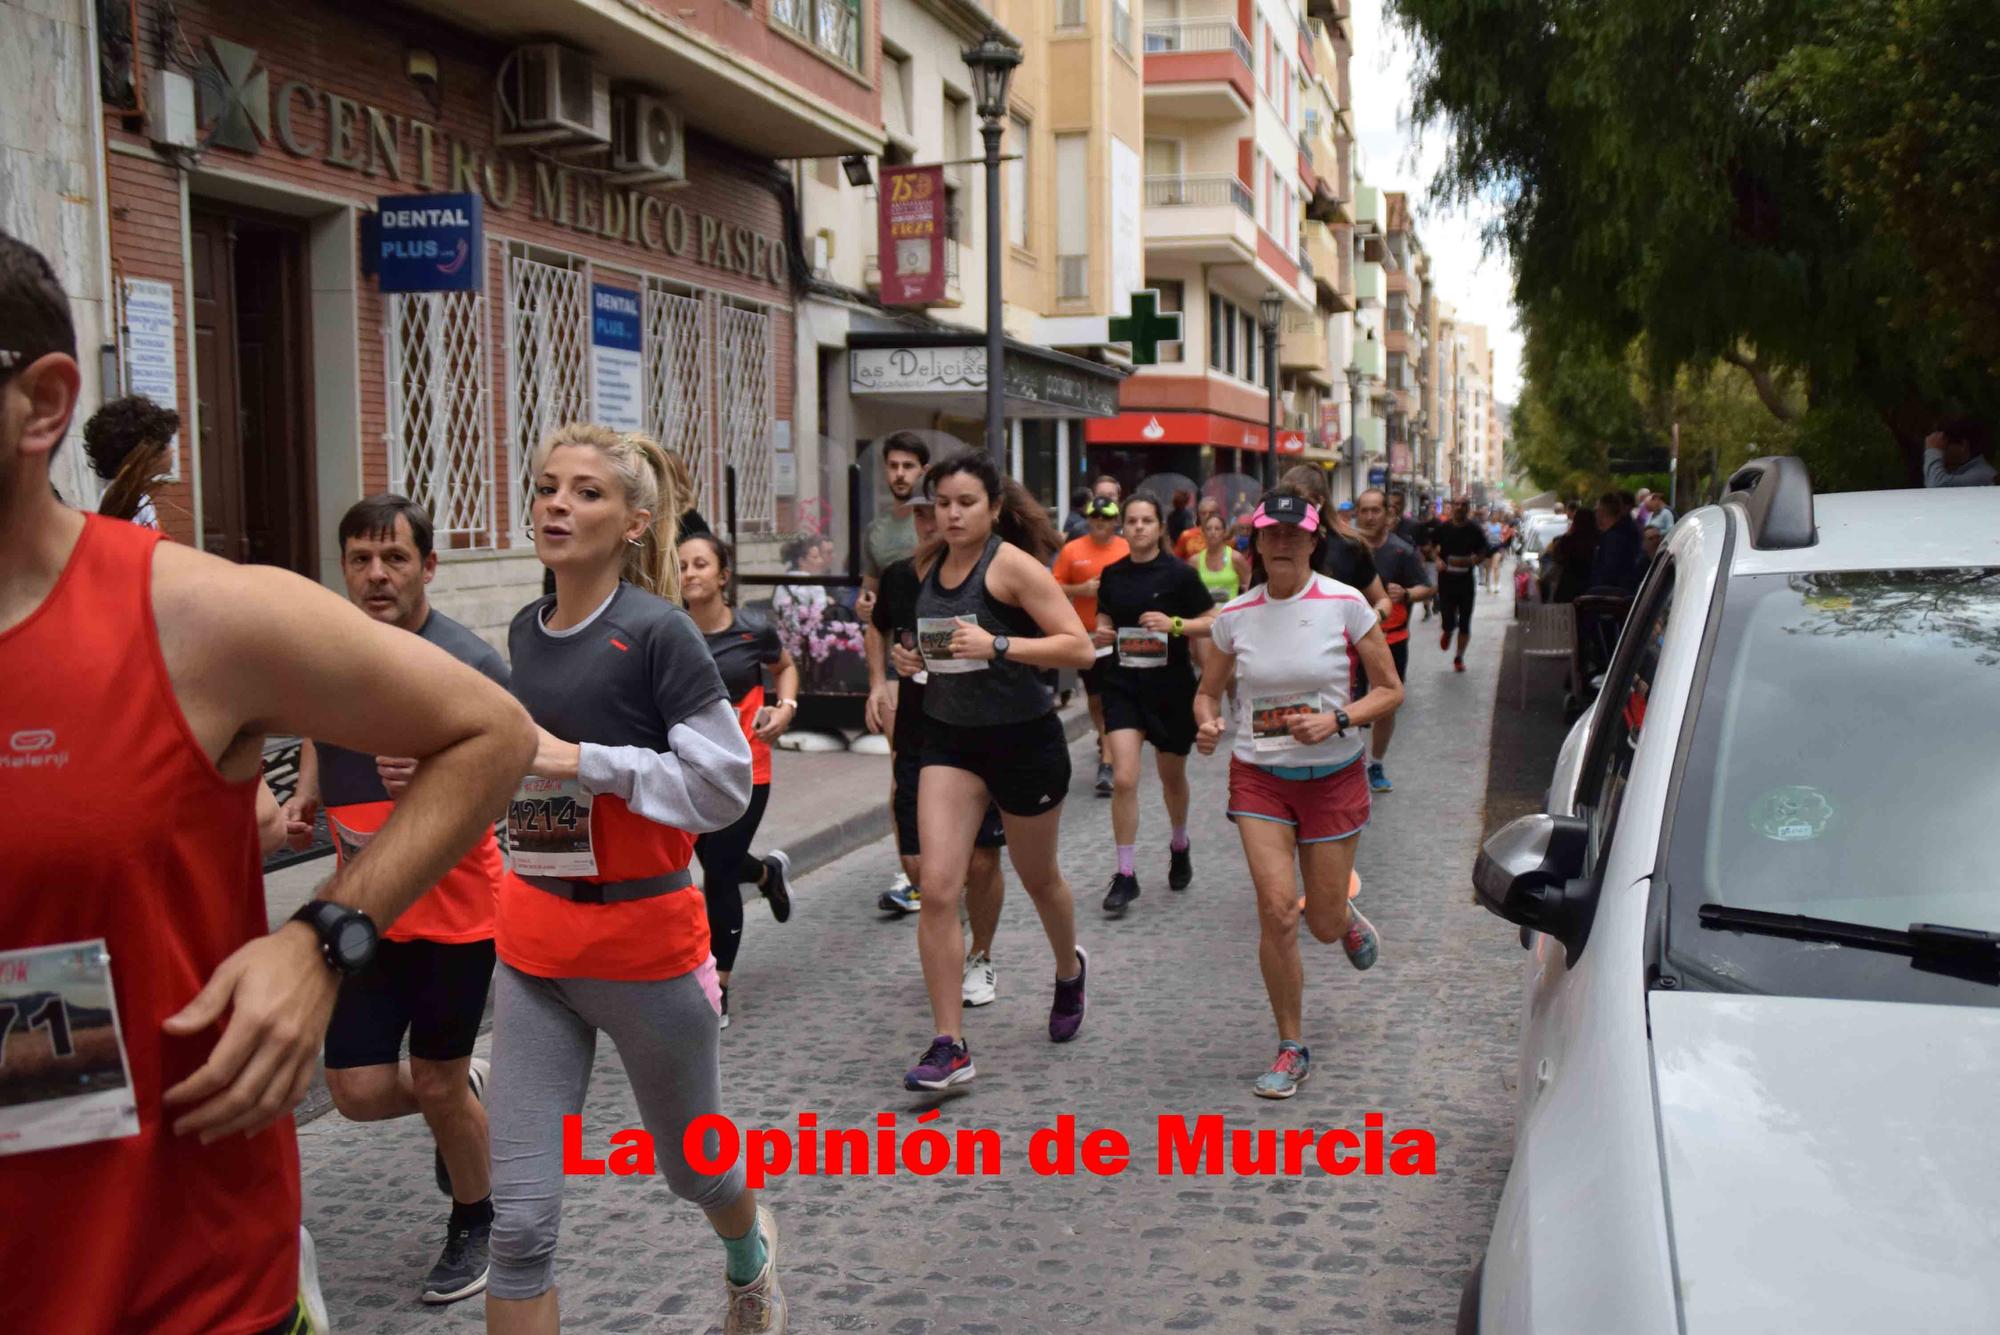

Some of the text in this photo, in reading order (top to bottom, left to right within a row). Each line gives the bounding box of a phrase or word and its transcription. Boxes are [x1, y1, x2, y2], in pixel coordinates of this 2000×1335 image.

[276, 80, 788, 287] CENTRO MEDICO PASEO
[381, 208, 470, 229] DENTAL
[381, 241, 438, 258] PLUS
[596, 291, 639, 316] DENTAL
[853, 348, 988, 388] Las Delicias
[511, 798, 578, 832] 1214
